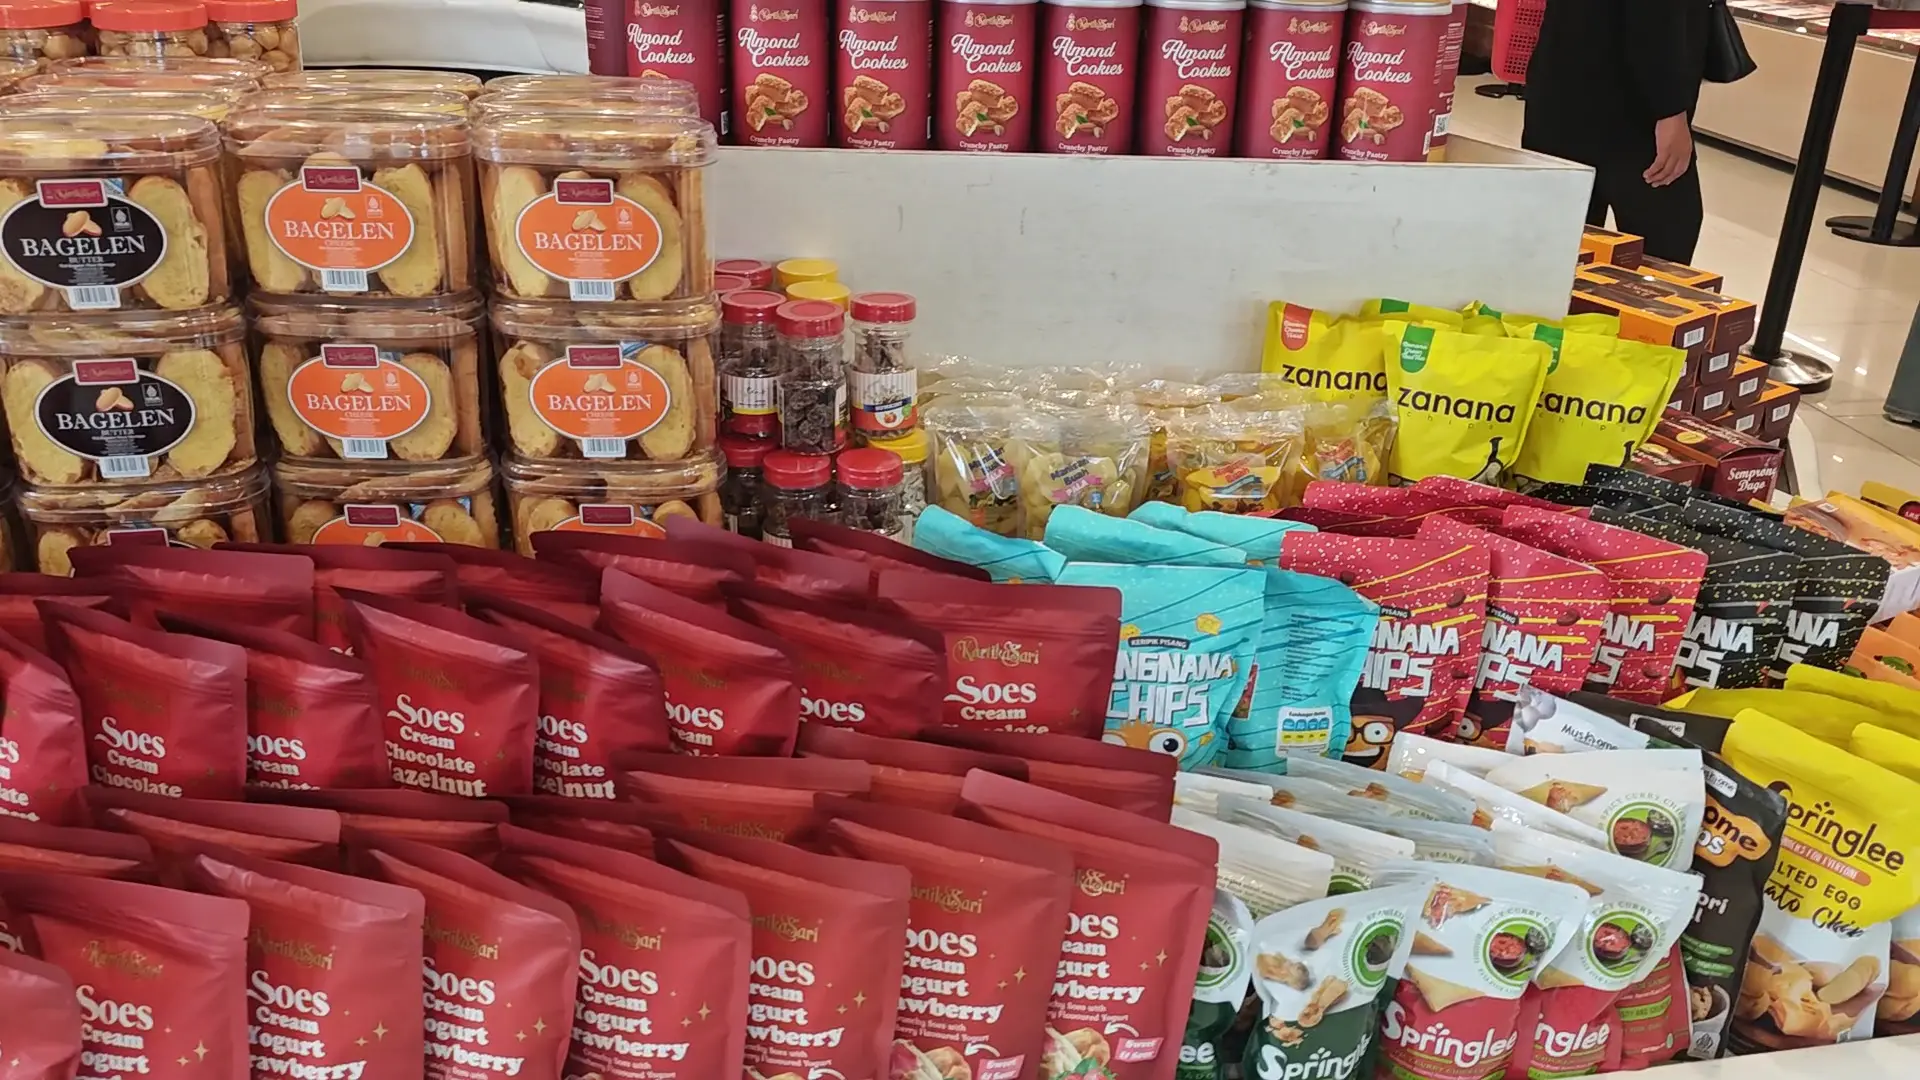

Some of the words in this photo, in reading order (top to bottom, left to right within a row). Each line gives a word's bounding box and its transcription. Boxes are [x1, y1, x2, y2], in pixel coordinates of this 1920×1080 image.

[627, 23, 683, 47] Almond
[738, 28, 800, 49] Almond
[839, 29, 898, 52] Almond
[951, 34, 1015, 55] Almond
[638, 45, 695, 64] Cookies
[752, 48, 810, 67] Cookies
[1053, 36, 1117, 58] Almond
[1162, 39, 1227, 61] Almond
[1270, 42, 1333, 63] Almond
[1347, 41, 1405, 65] Almond
[851, 51, 908, 69] Cookies
[966, 53, 1022, 74] Cookies
[1066, 57, 1124, 76] Cookies
[1178, 59, 1231, 79] Cookies
[1285, 62, 1335, 81] Cookies
[1354, 63, 1412, 84] Cookies
[284, 220, 394, 240] BAGELEN
[534, 232, 643, 251] BAGELEN
[20, 235, 146, 257] BAGELEN
[305, 393, 412, 411] BAGELEN
[547, 394, 652, 411] BAGELEN
[1397, 386, 1516, 424] zanana
[55, 408, 175, 430] BAGELEN
[943, 676, 1037, 704] Soes
[387, 693, 465, 734] Soes
[960, 706, 1027, 720] Cream
[1106, 682, 1210, 728] CHIPS
[94, 716, 166, 759] Soes
[400, 725, 455, 750] Cream
[107, 751, 159, 774] Cream
[384, 740, 475, 774] Chocolate
[93, 764, 182, 798] Chocolate
[388, 758, 487, 797] azelnut
[1823, 884, 1861, 911] EGG
[423, 957, 495, 1005] Soes
[579, 948, 659, 995] Soes
[246, 970, 331, 1017] Soes
[581, 984, 648, 1012] Cream
[76, 985, 154, 1031] Soes
[423, 992, 484, 1022] Cream
[256, 1006, 319, 1035] Cream
[81, 1022, 144, 1050] Cream
[248, 1025, 326, 1058] Yogurt
[1381, 1001, 1518, 1068] Springlee
